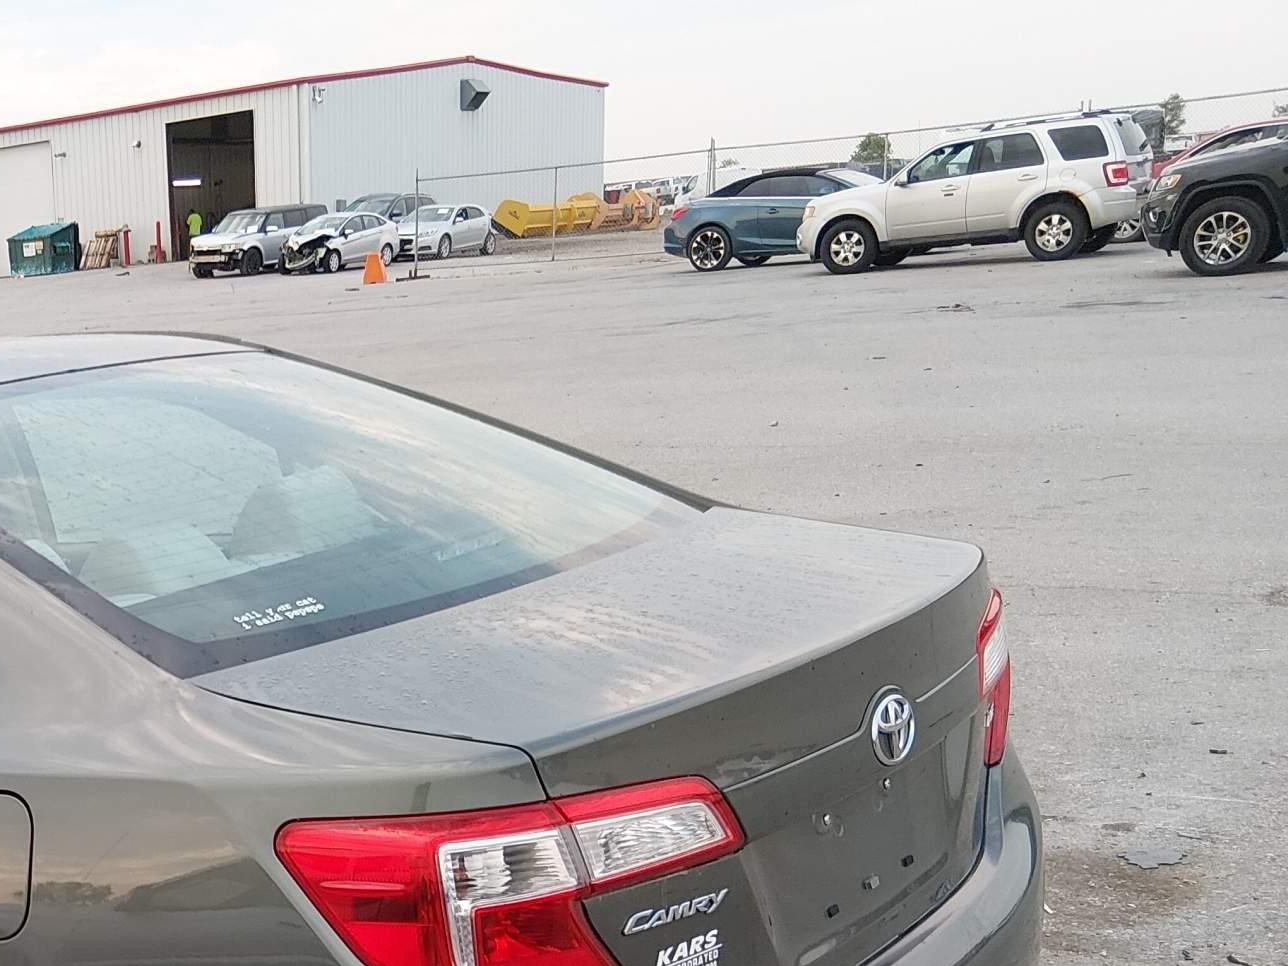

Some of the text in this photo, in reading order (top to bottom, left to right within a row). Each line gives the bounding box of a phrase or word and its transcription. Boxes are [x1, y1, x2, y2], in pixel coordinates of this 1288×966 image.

[233, 610, 262, 623] tell
[295, 596, 317, 607] cat
[255, 613, 283, 626] said
[622, 887, 729, 936] CAMRY
